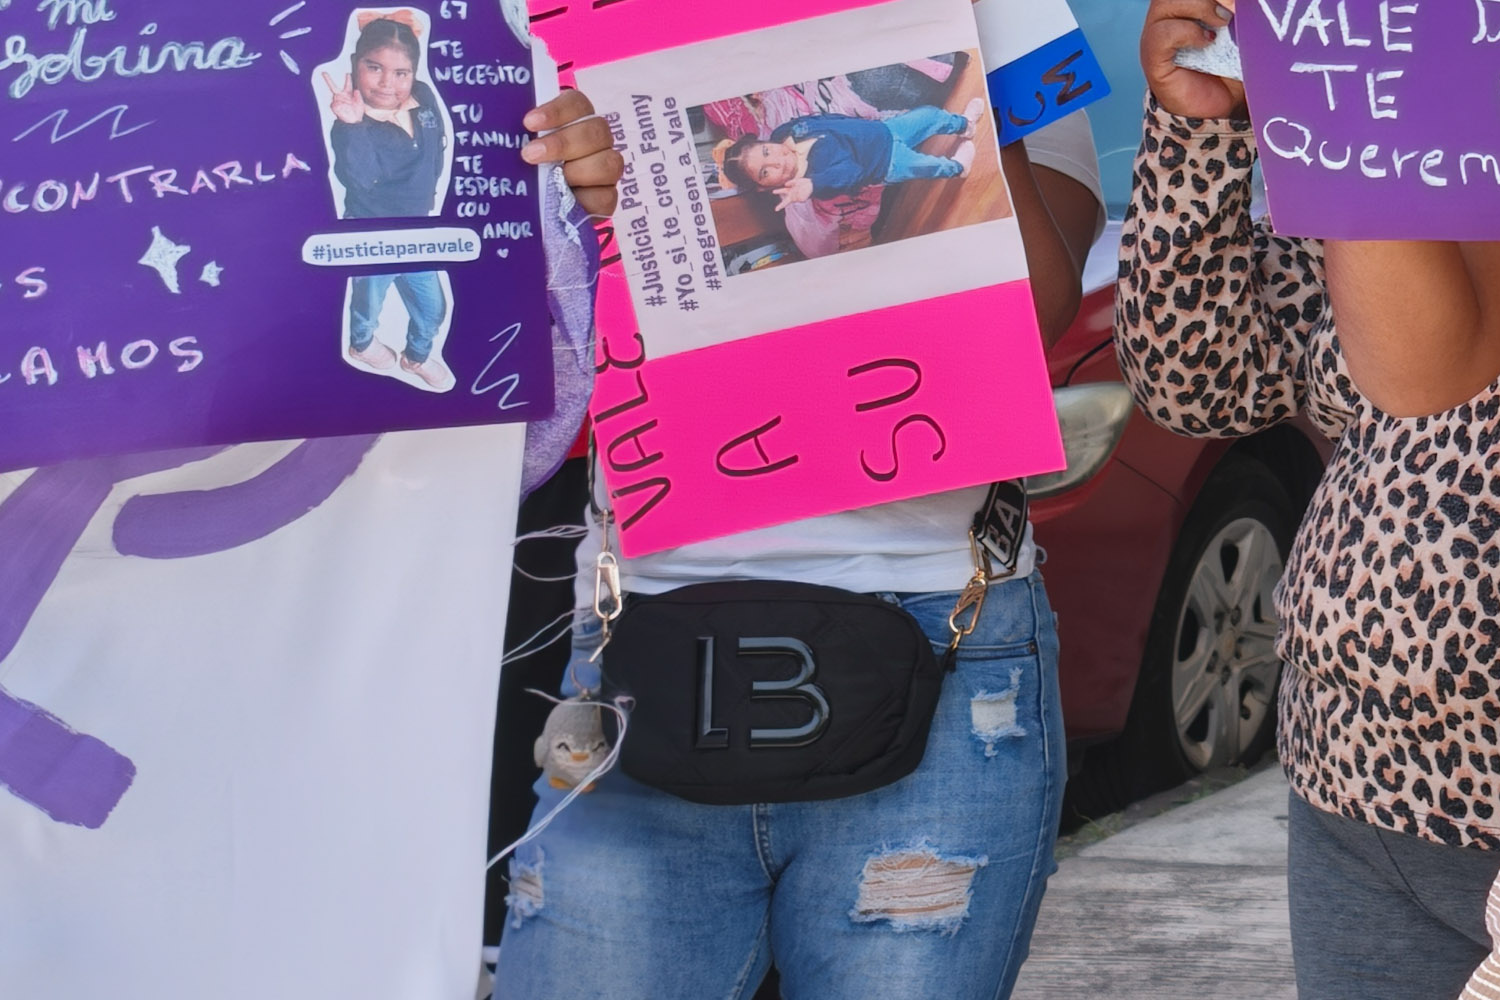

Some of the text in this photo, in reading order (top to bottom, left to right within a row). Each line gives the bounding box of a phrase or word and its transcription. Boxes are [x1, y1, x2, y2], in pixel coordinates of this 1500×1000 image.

[428, 39, 464, 60] TE
[1289, 62, 1405, 121] TE
[451, 102, 484, 125] TU
[455, 154, 484, 175] TE
[0, 152, 311, 214] CONTRARLA
[454, 175, 528, 199] ESPERA
[663, 96, 723, 291] #Regresen_a_Vale
[630, 93, 700, 312] #Yo_si_te_creo_Fanny
[482, 221, 534, 241] AMOR
[312, 236, 475, 262] #justiciaparavale
[715, 414, 800, 479] A
